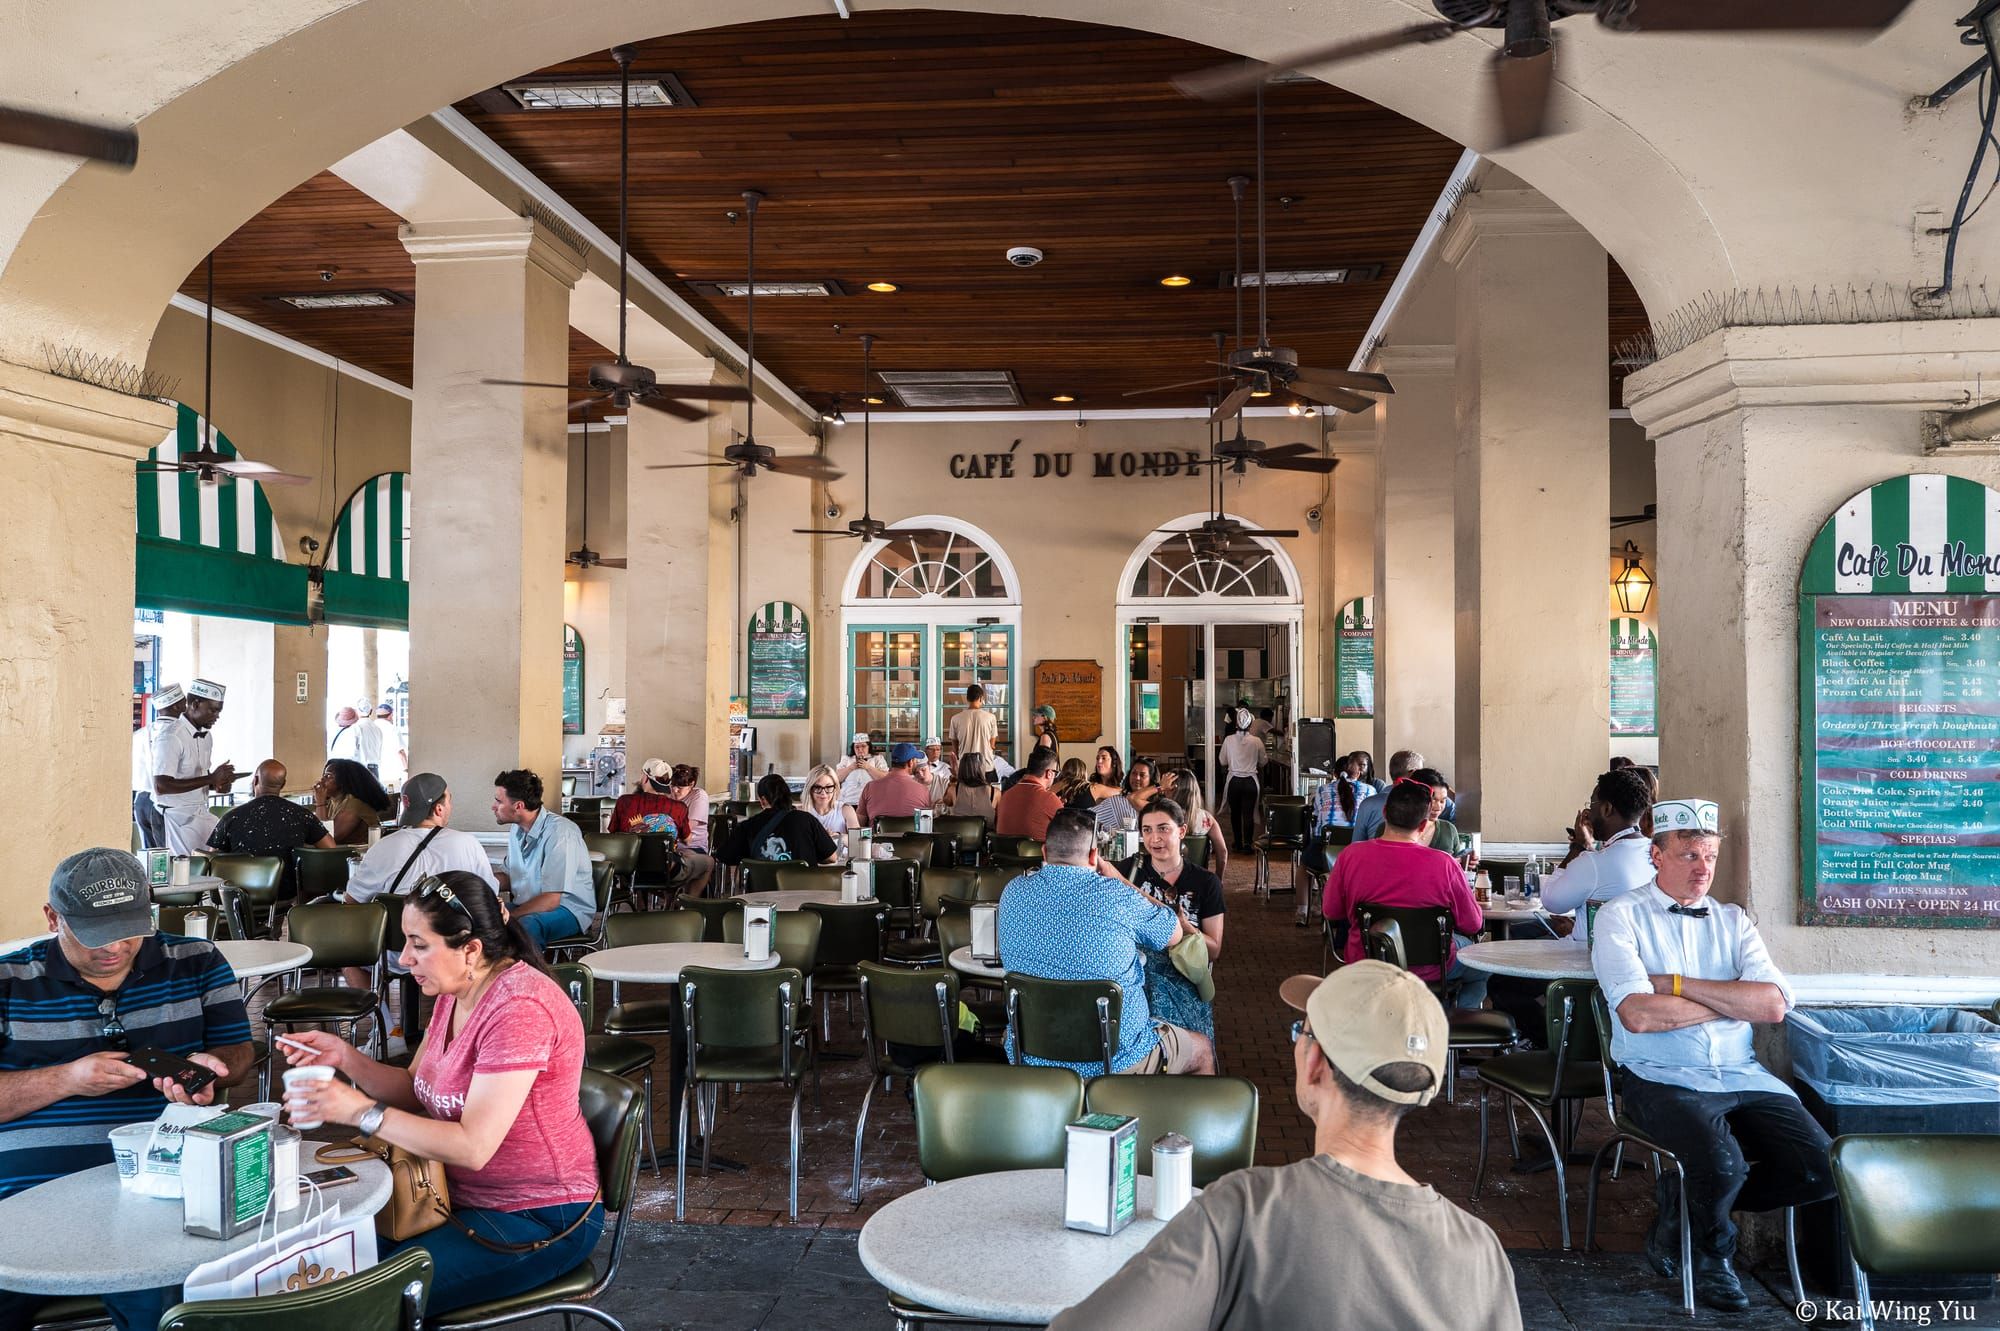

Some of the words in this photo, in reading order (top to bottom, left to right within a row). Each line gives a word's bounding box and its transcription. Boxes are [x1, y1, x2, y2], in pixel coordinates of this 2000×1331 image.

[950, 439, 1021, 479] CAFÉ
[1033, 453, 1074, 478] DU
[1093, 452, 1201, 478] MONDE
[1837, 541, 1890, 577] Café
[1896, 542, 1933, 577] Du
[1891, 601, 1958, 616] MENU
[1830, 619, 1855, 627] NEW
[1857, 619, 1910, 627] ORLEANS
[1912, 619, 1957, 627] COFFEE
[1960, 619, 1969, 627] &
[1821, 633, 1844, 641] Café
[1846, 633, 1860, 641] Au
[1863, 633, 1883, 641] Lait
[1961, 633, 1981, 641] 3.40
[1822, 659, 1850, 667] Black
[1853, 659, 1885, 667] Coffee
[1822, 677, 1844, 686] Iced
[1846, 677, 1869, 686] Café
[1872, 677, 1886, 686] Au
[1823, 688, 1857, 696] Frozen
[1860, 688, 1882, 696] Café
[1885, 688, 1899, 696] Au
[1902, 688, 1923, 696] Lait
[1899, 704, 1957, 713] BEIGNETS
[1822, 721, 1857, 729] Orders
[1859, 721, 1870, 730] of
[1871, 721, 1900, 729] Three
[1903, 721, 1939, 730] French
[1942, 721, 1997, 731] Doughnuts
[1880, 740, 1905, 748] HOT
[1907, 740, 1976, 748] CHOCOLATE
[1906, 755, 1927, 763] 3.40
[1890, 771, 1921, 779] COLD
[1924, 771, 1967, 780] DRINKS
[1822, 787, 1850, 796] Coke,
[1877, 787, 1906, 796] Coke,
[1908, 787, 1941, 797] Sprite
[1963, 788, 1984, 796] 3.40
[1822, 798, 1859, 808] Orange
[1861, 798, 1889, 807] Juice
[1962, 799, 1983, 808] 3.40
[1823, 809, 1853, 817] Bottle
[1855, 809, 1890, 818] Spring
[1892, 809, 1923, 818] Water
[1823, 820, 1846, 828] Cold
[1849, 820, 1872, 828] Milk
[1962, 821, 1983, 829] 3.40
[1901, 835, 1957, 844] SPECIALS
[1822, 860, 1857, 868] Served
[1860, 860, 1870, 868] in
[1873, 860, 1894, 869] Full
[1897, 861, 1926, 869] Color
[1928, 861, 1951, 871] Mug
[1822, 871, 1857, 879] Served
[1860, 871, 1870, 879] in
[1873, 871, 1889, 880] the
[1892, 872, 1918, 881] Logo
[1920, 872, 1943, 881] Mug
[1888, 887, 1914, 895] PLUS
[1916, 887, 1947, 895] SALES
[1948, 887, 1969, 895] TAX
[1823, 898, 1861, 909] CASH
[1865, 898, 1906, 909] ONLY
[1918, 899, 1960, 910] OPEN
[1963, 901, 1979, 911] 24
